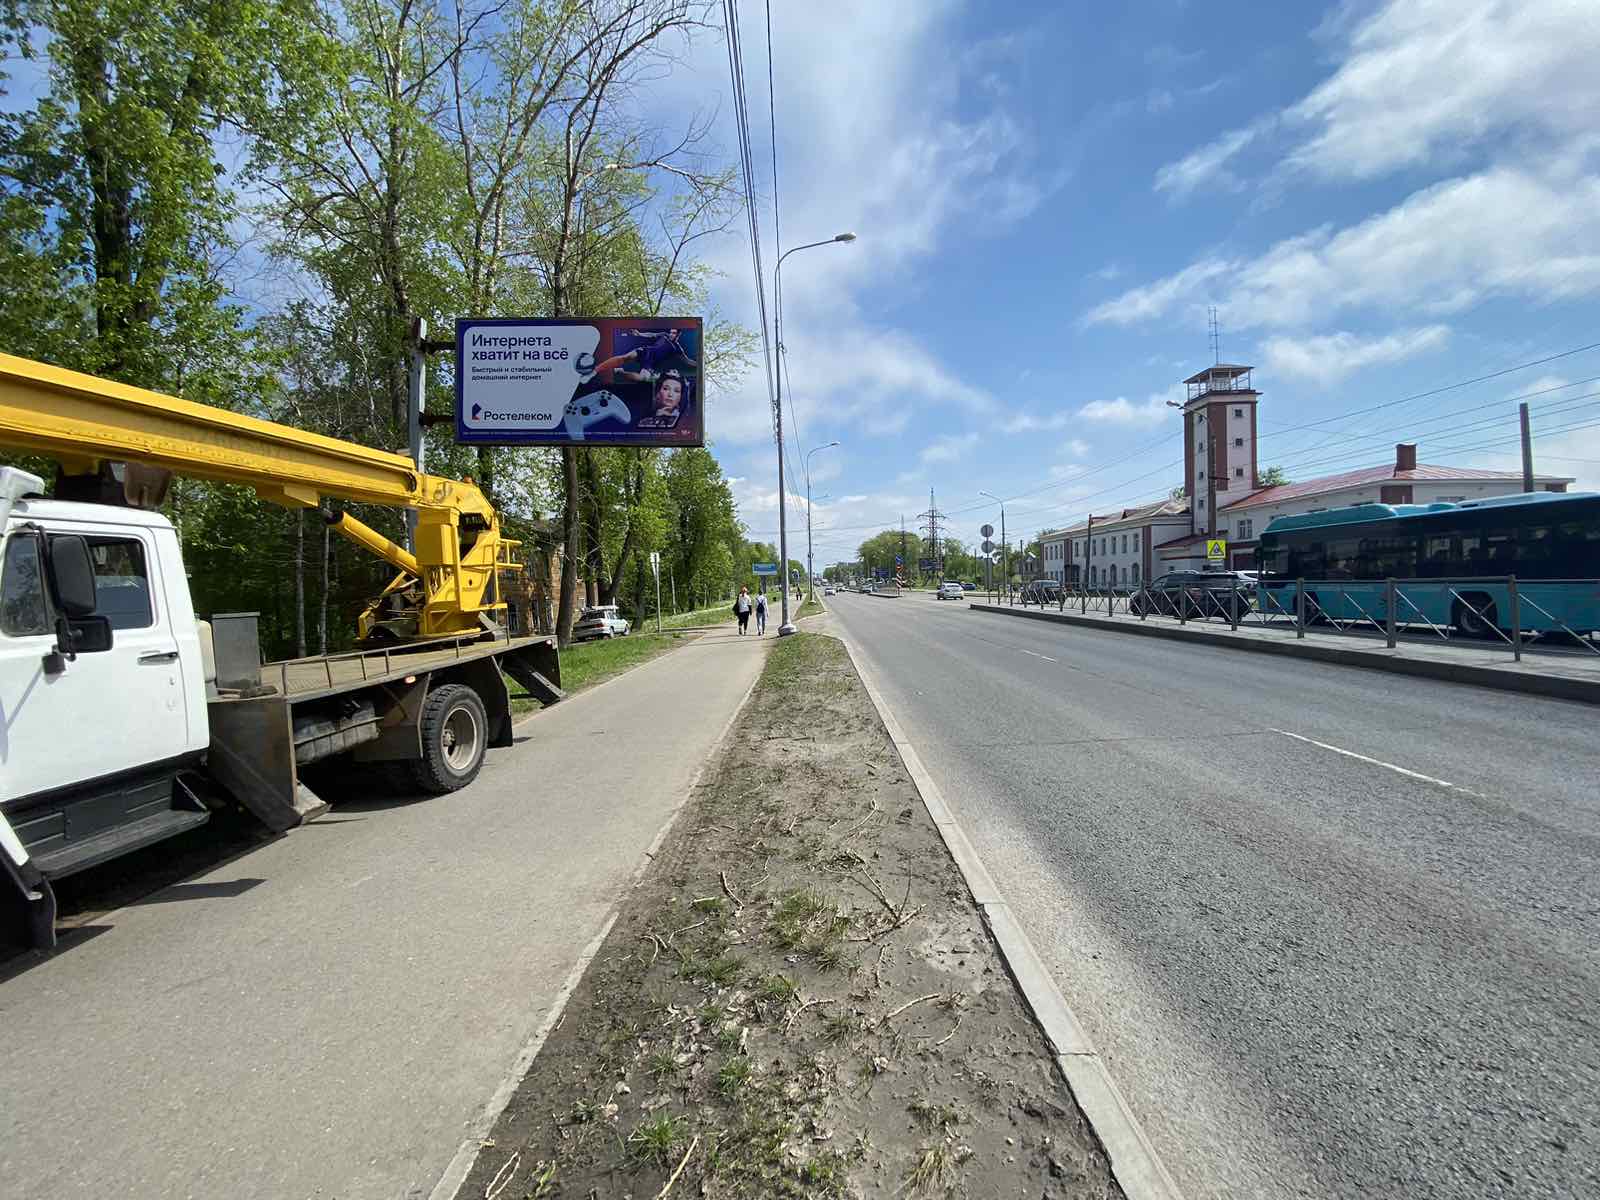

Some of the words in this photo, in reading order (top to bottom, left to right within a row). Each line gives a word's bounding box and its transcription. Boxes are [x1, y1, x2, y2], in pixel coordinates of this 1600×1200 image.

[472, 333, 552, 350] Интернета
[471, 350, 520, 361] хватит
[522, 350, 540, 361] на
[543, 346, 569, 361] всё
[483, 411, 552, 421] Ростелеком
